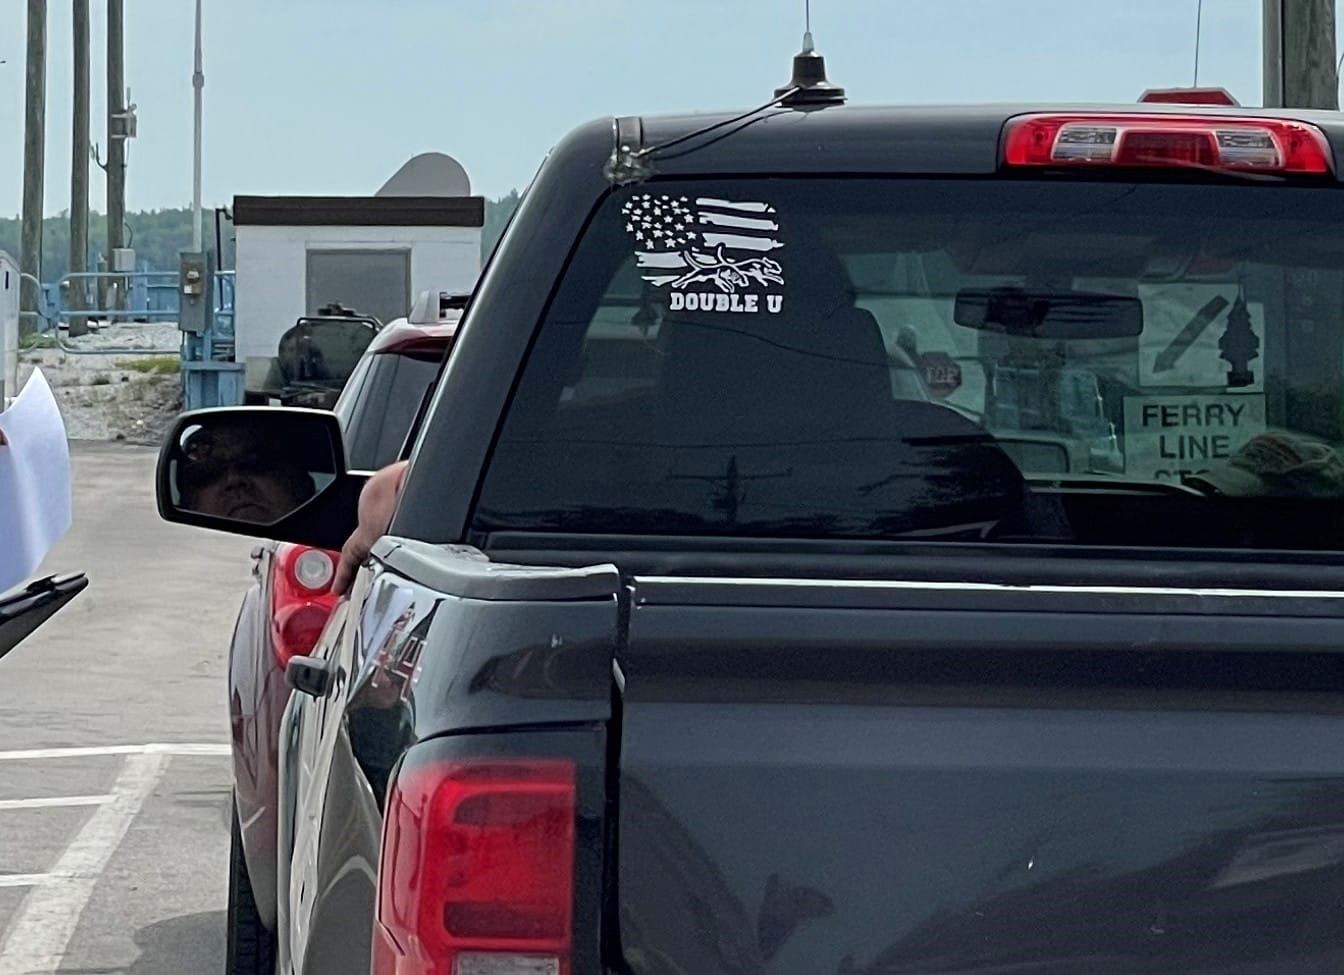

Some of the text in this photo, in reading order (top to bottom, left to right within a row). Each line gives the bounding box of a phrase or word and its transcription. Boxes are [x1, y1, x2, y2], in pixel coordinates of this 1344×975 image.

[669, 292, 783, 313] DOUBLE U
[1141, 403, 1246, 428] FERRY
[1159, 434, 1231, 460] LINE
